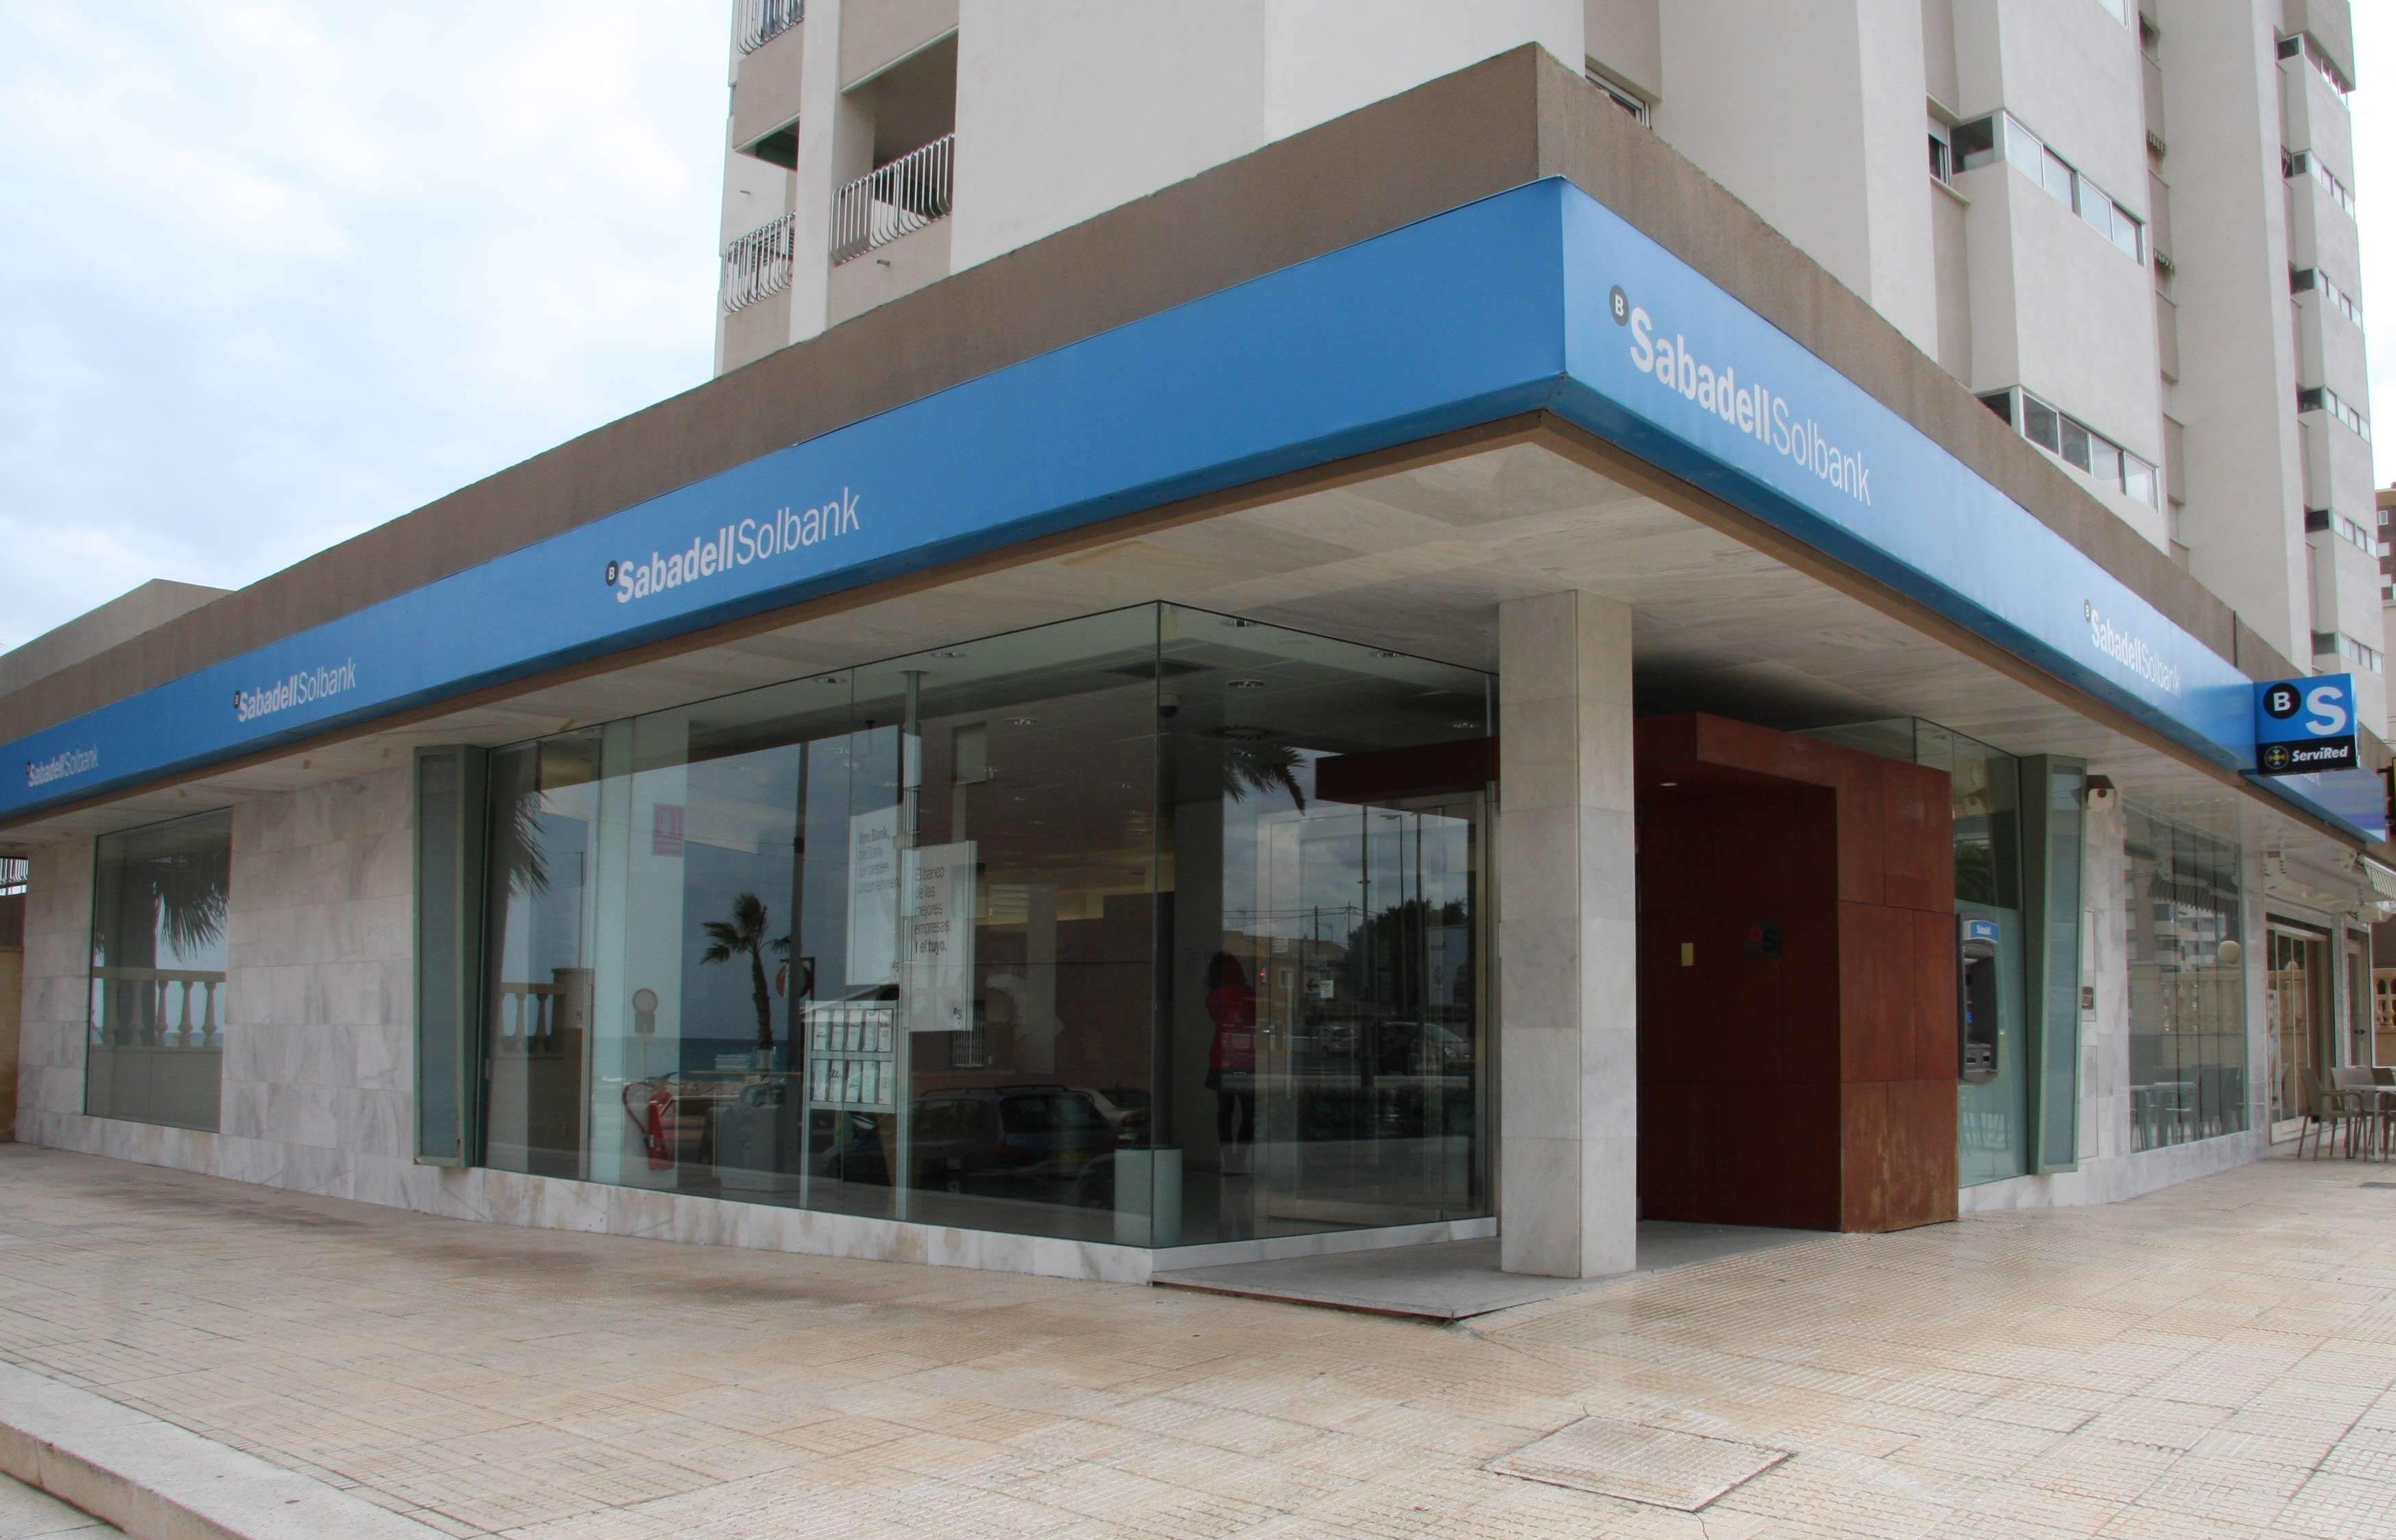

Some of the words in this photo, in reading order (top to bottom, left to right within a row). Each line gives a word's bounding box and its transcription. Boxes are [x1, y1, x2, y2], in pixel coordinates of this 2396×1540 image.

[2305, 686, 2347, 735] S
[2291, 745, 2348, 763] ServiRed
[922, 866, 944, 881] banco
